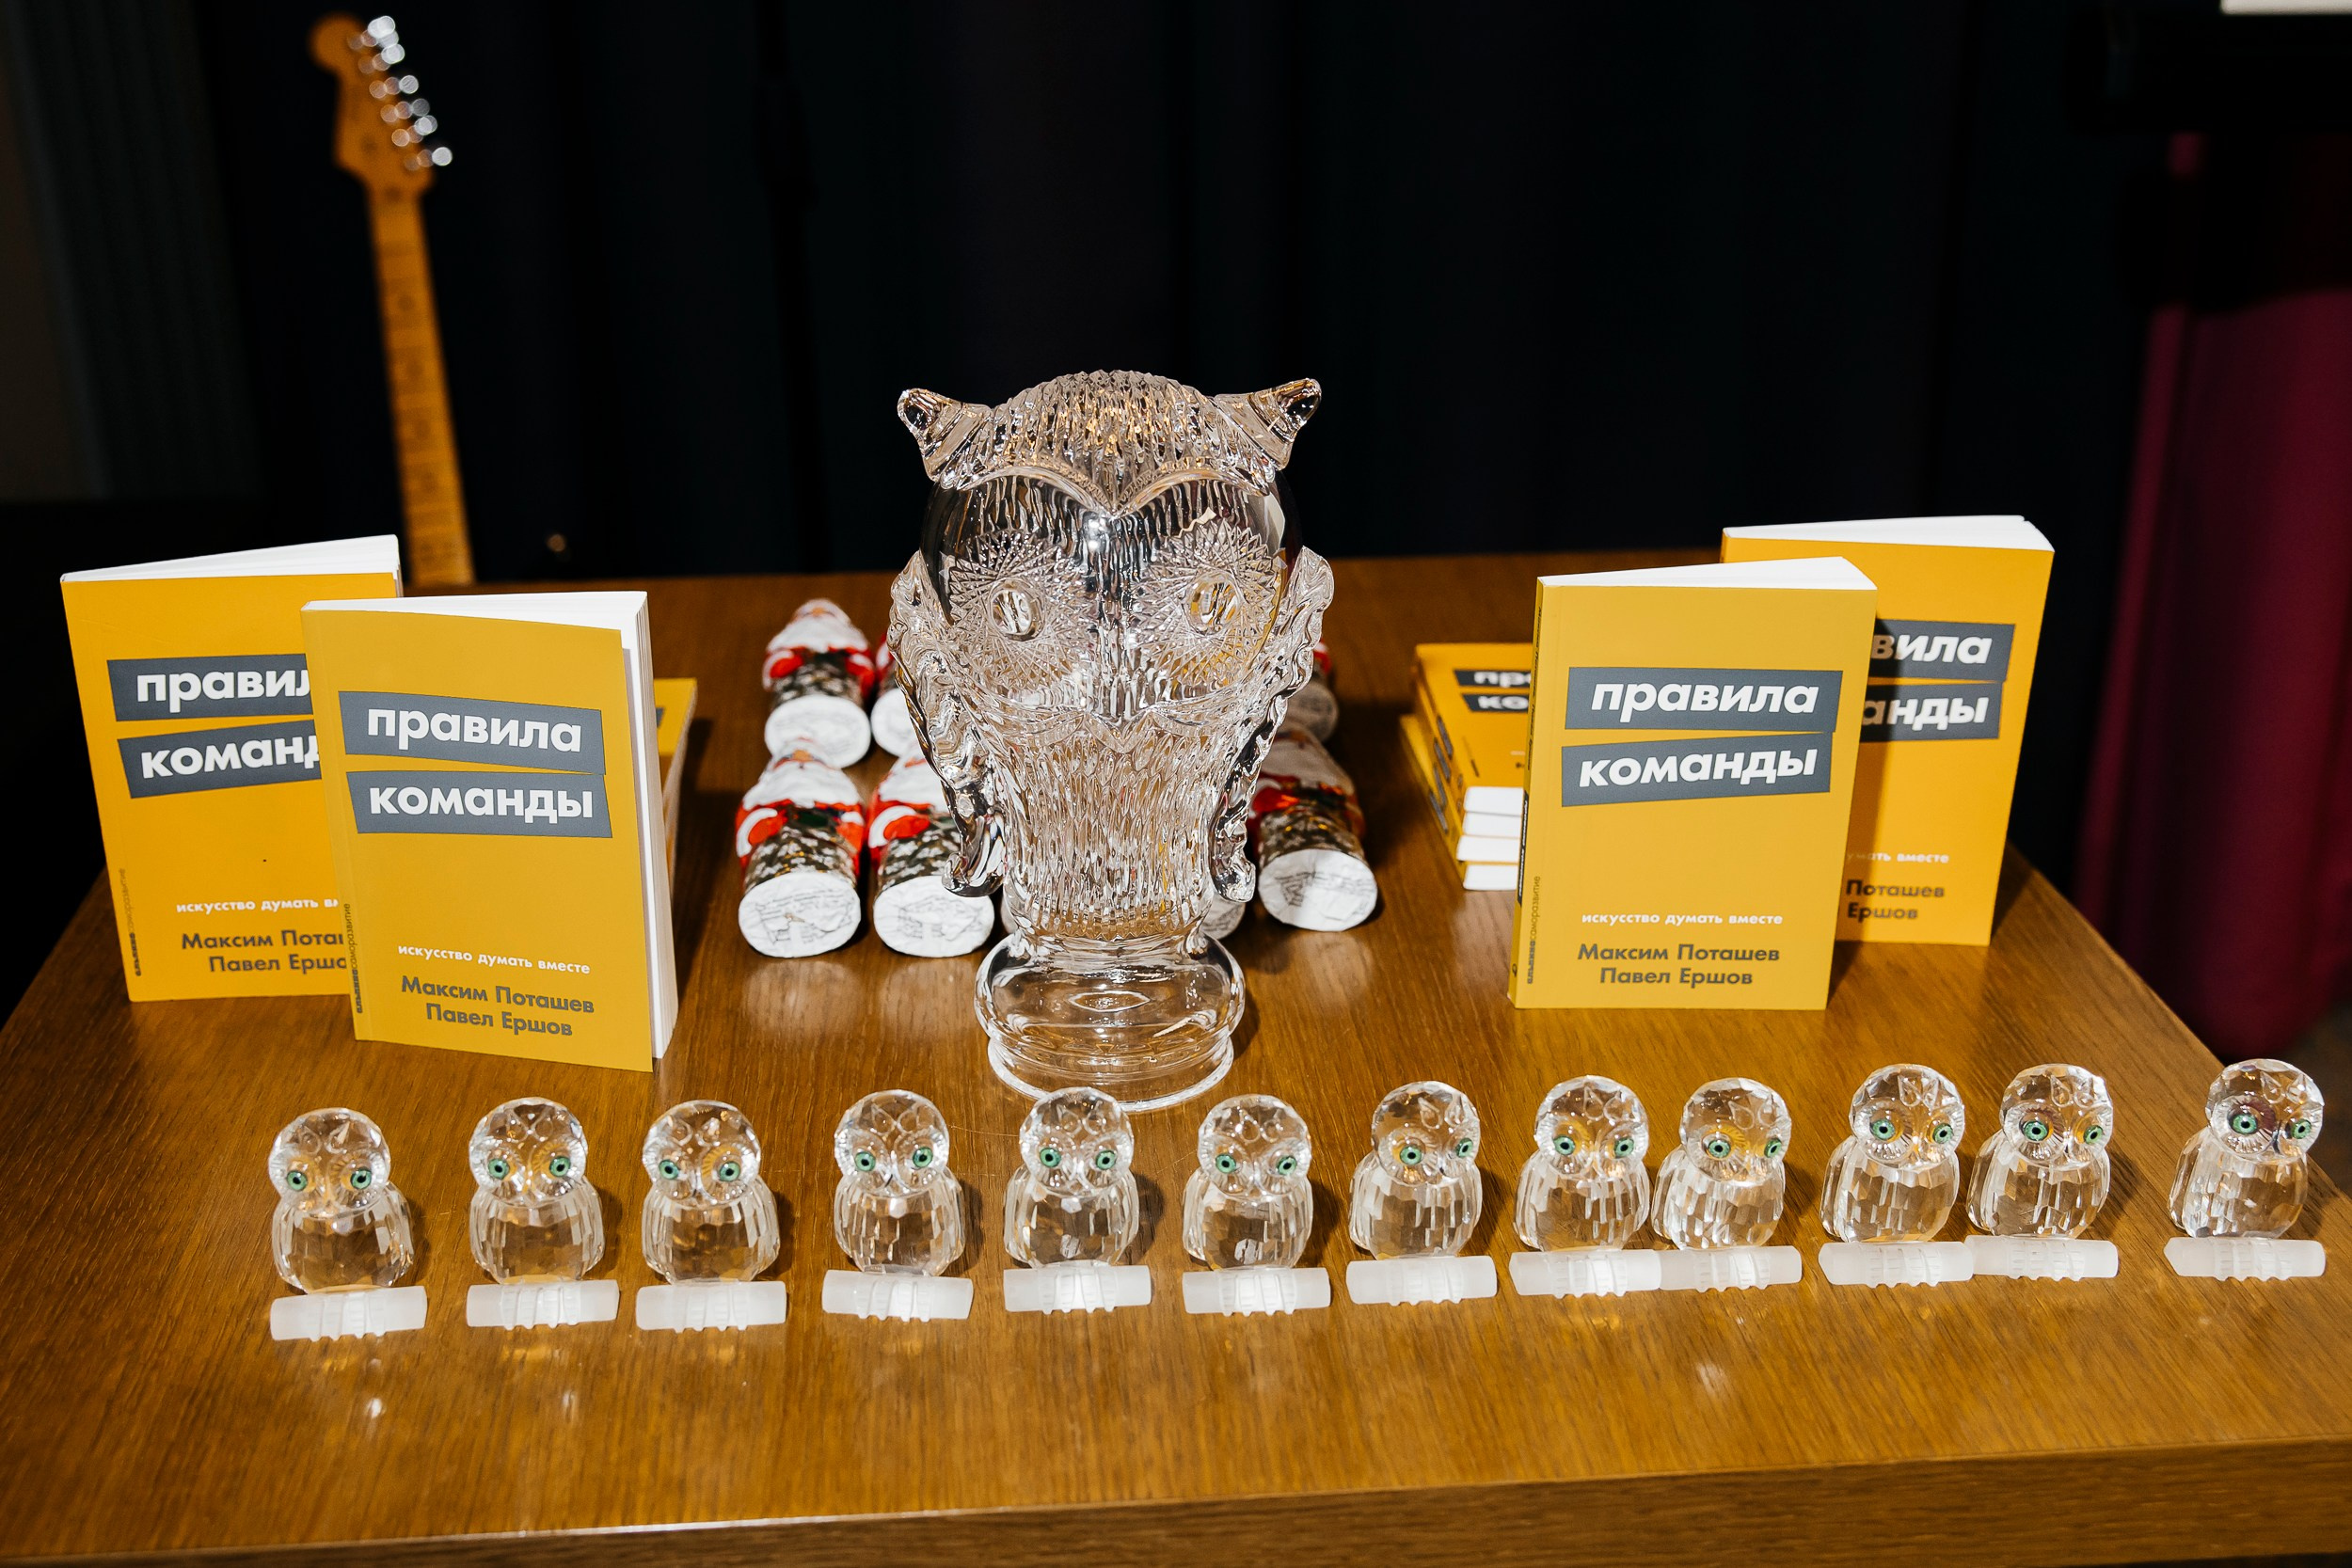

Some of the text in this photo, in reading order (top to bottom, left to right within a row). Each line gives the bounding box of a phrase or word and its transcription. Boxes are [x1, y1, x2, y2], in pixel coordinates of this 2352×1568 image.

[1473, 671, 1532, 688] пр
[1591, 683, 1820, 723] правила
[368, 708, 581, 752] правила
[1579, 749, 1818, 788] команды
[369, 786, 593, 824] команды
[1846, 879, 1945, 897] Поташев
[176, 900, 256, 915] искусство
[261, 898, 319, 913] думать
[1847, 901, 1918, 923] Ершов
[1581, 913, 1784, 927] искусство думать вместе
[182, 929, 344, 950] Максим Пота
[398, 944, 591, 974] искусство думать вместе
[1577, 943, 1780, 961] Максим Поташев
[209, 956, 280, 973] Павел
[1599, 968, 1754, 989] Павел Ершов
[402, 974, 595, 1013] Максим Поташев
[426, 1003, 573, 1037] Павел Ершов
